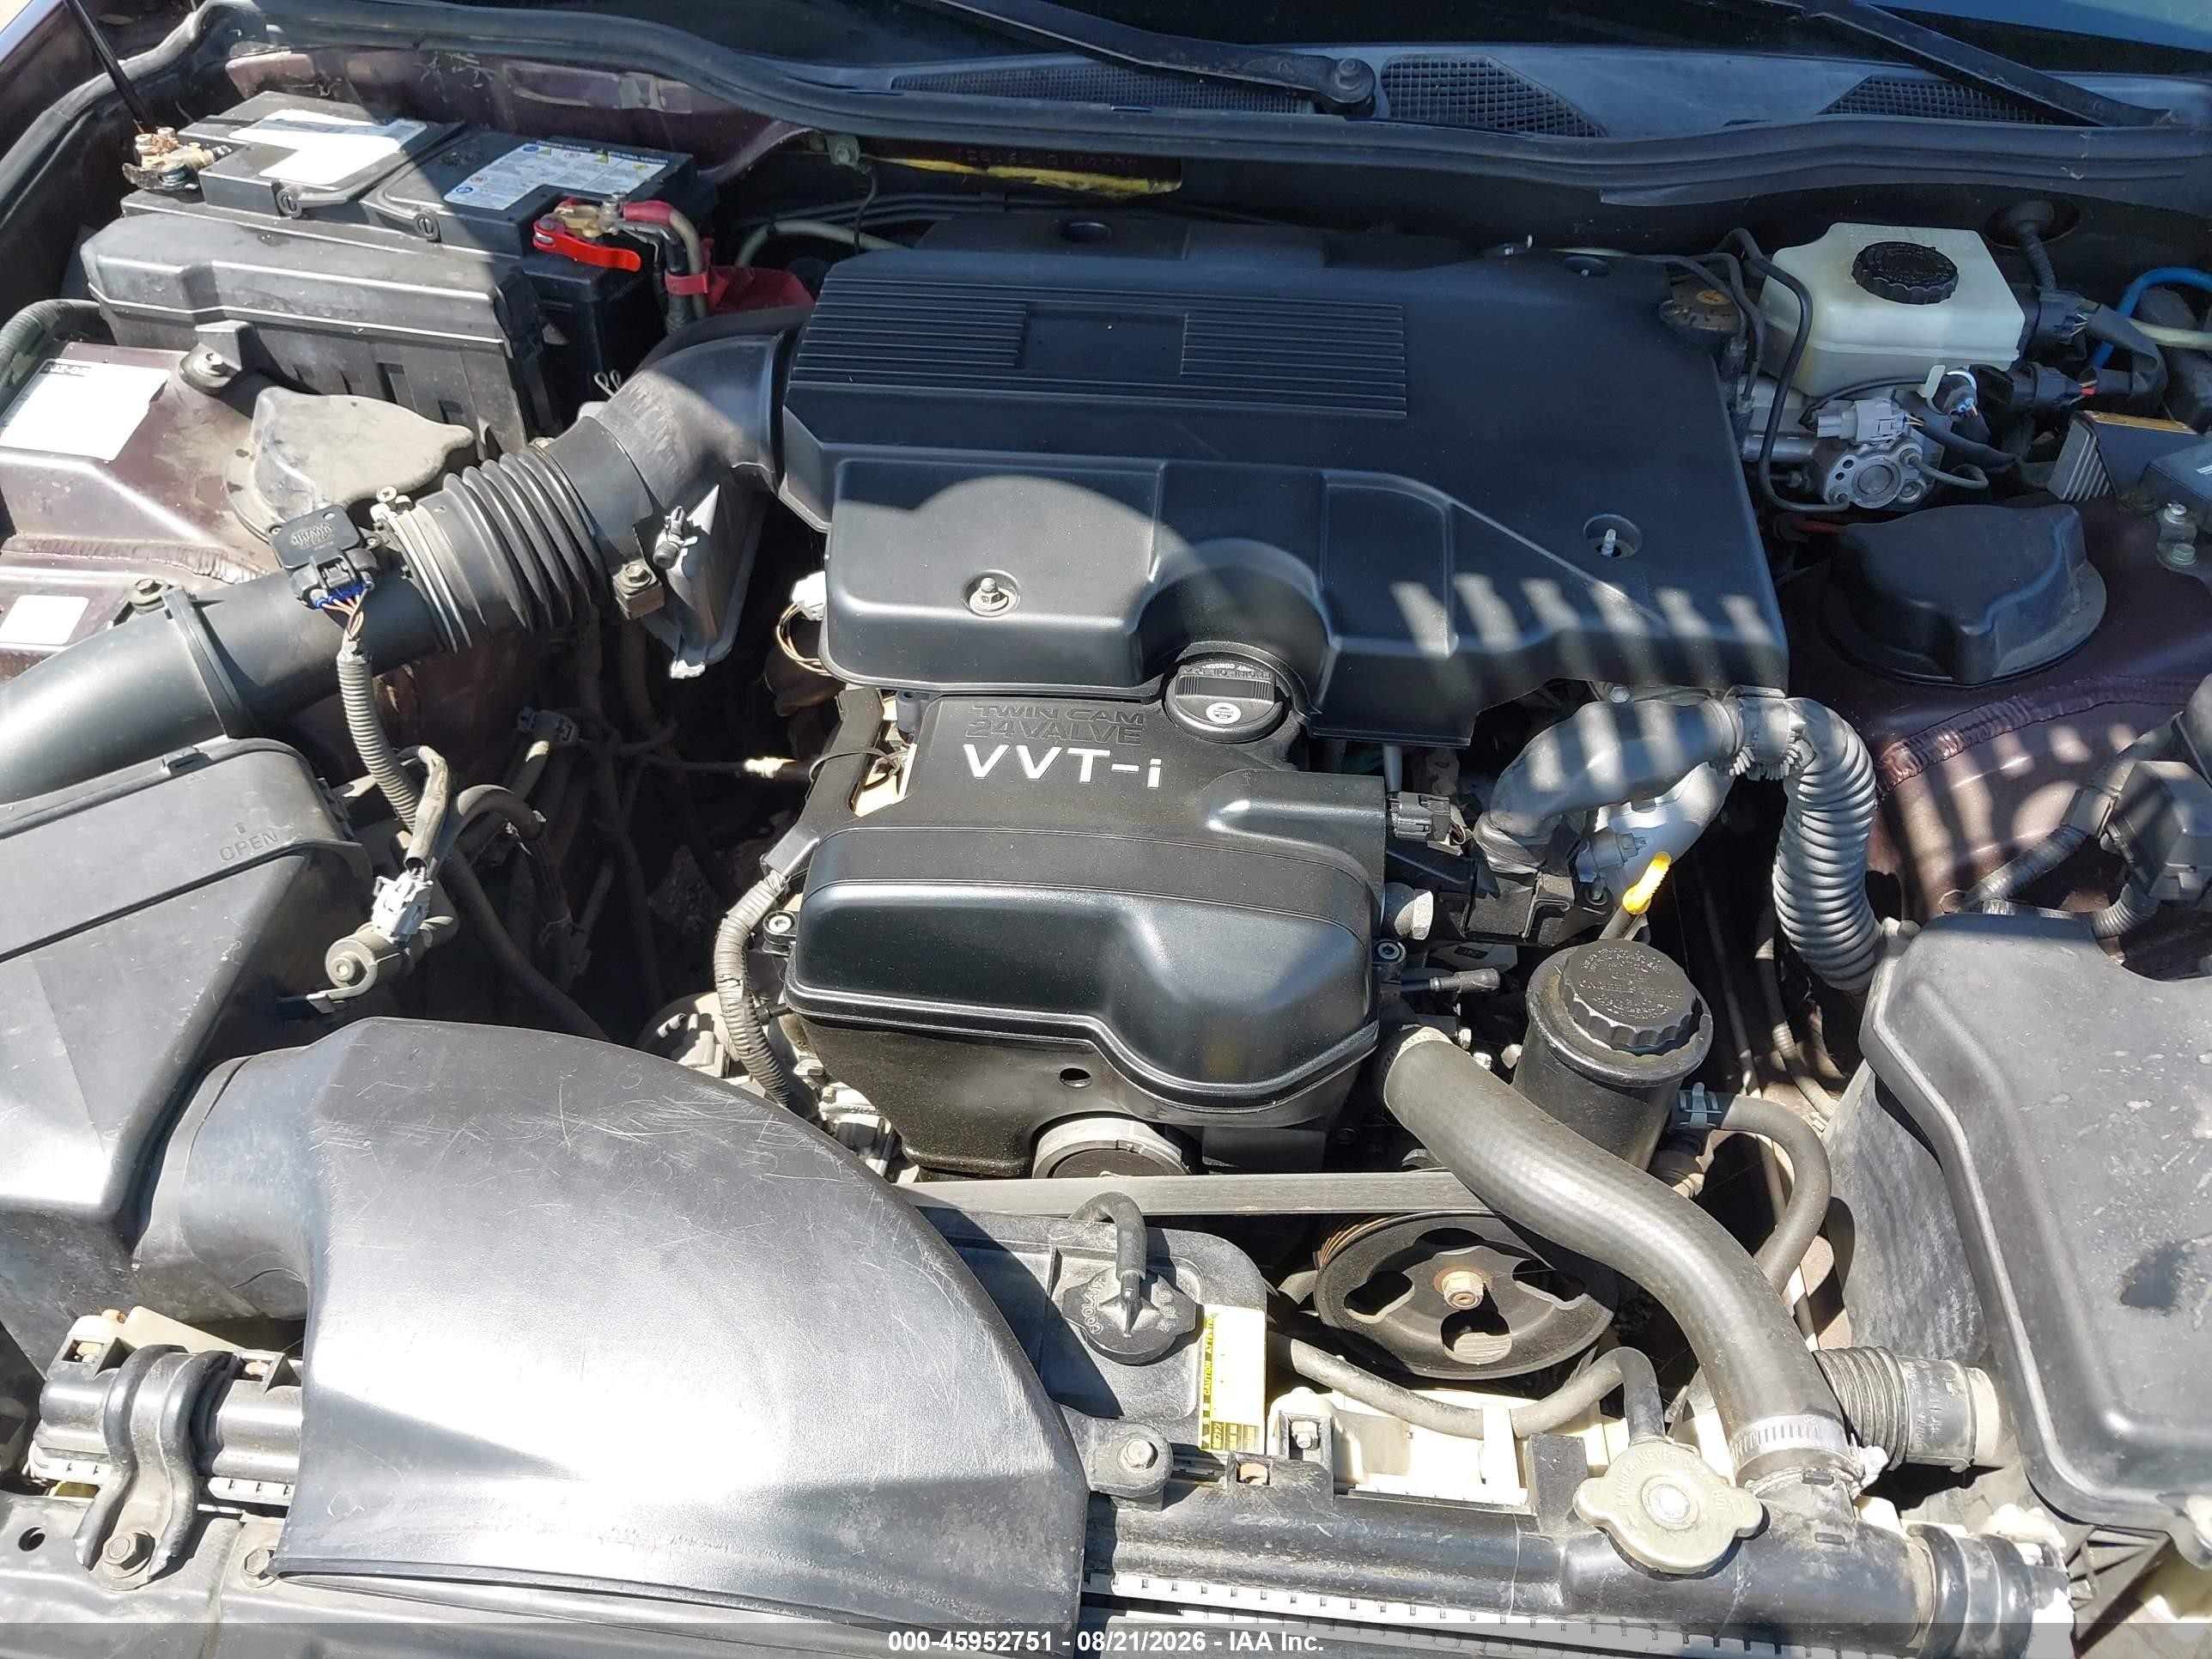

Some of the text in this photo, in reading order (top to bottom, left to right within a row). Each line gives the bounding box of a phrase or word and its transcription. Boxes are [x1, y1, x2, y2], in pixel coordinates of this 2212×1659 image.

[971, 704, 1146, 726] TWIN CAM
[965, 720, 1145, 746] 24VALVE
[963, 744, 1163, 789] VVT-i
[219, 830, 279, 861] OPEN
[1080, 1275, 1108, 1335] COOLANT
[1203, 1359, 1213, 1396] CAUTION
[1640, 1449, 1680, 1466] NEVER
